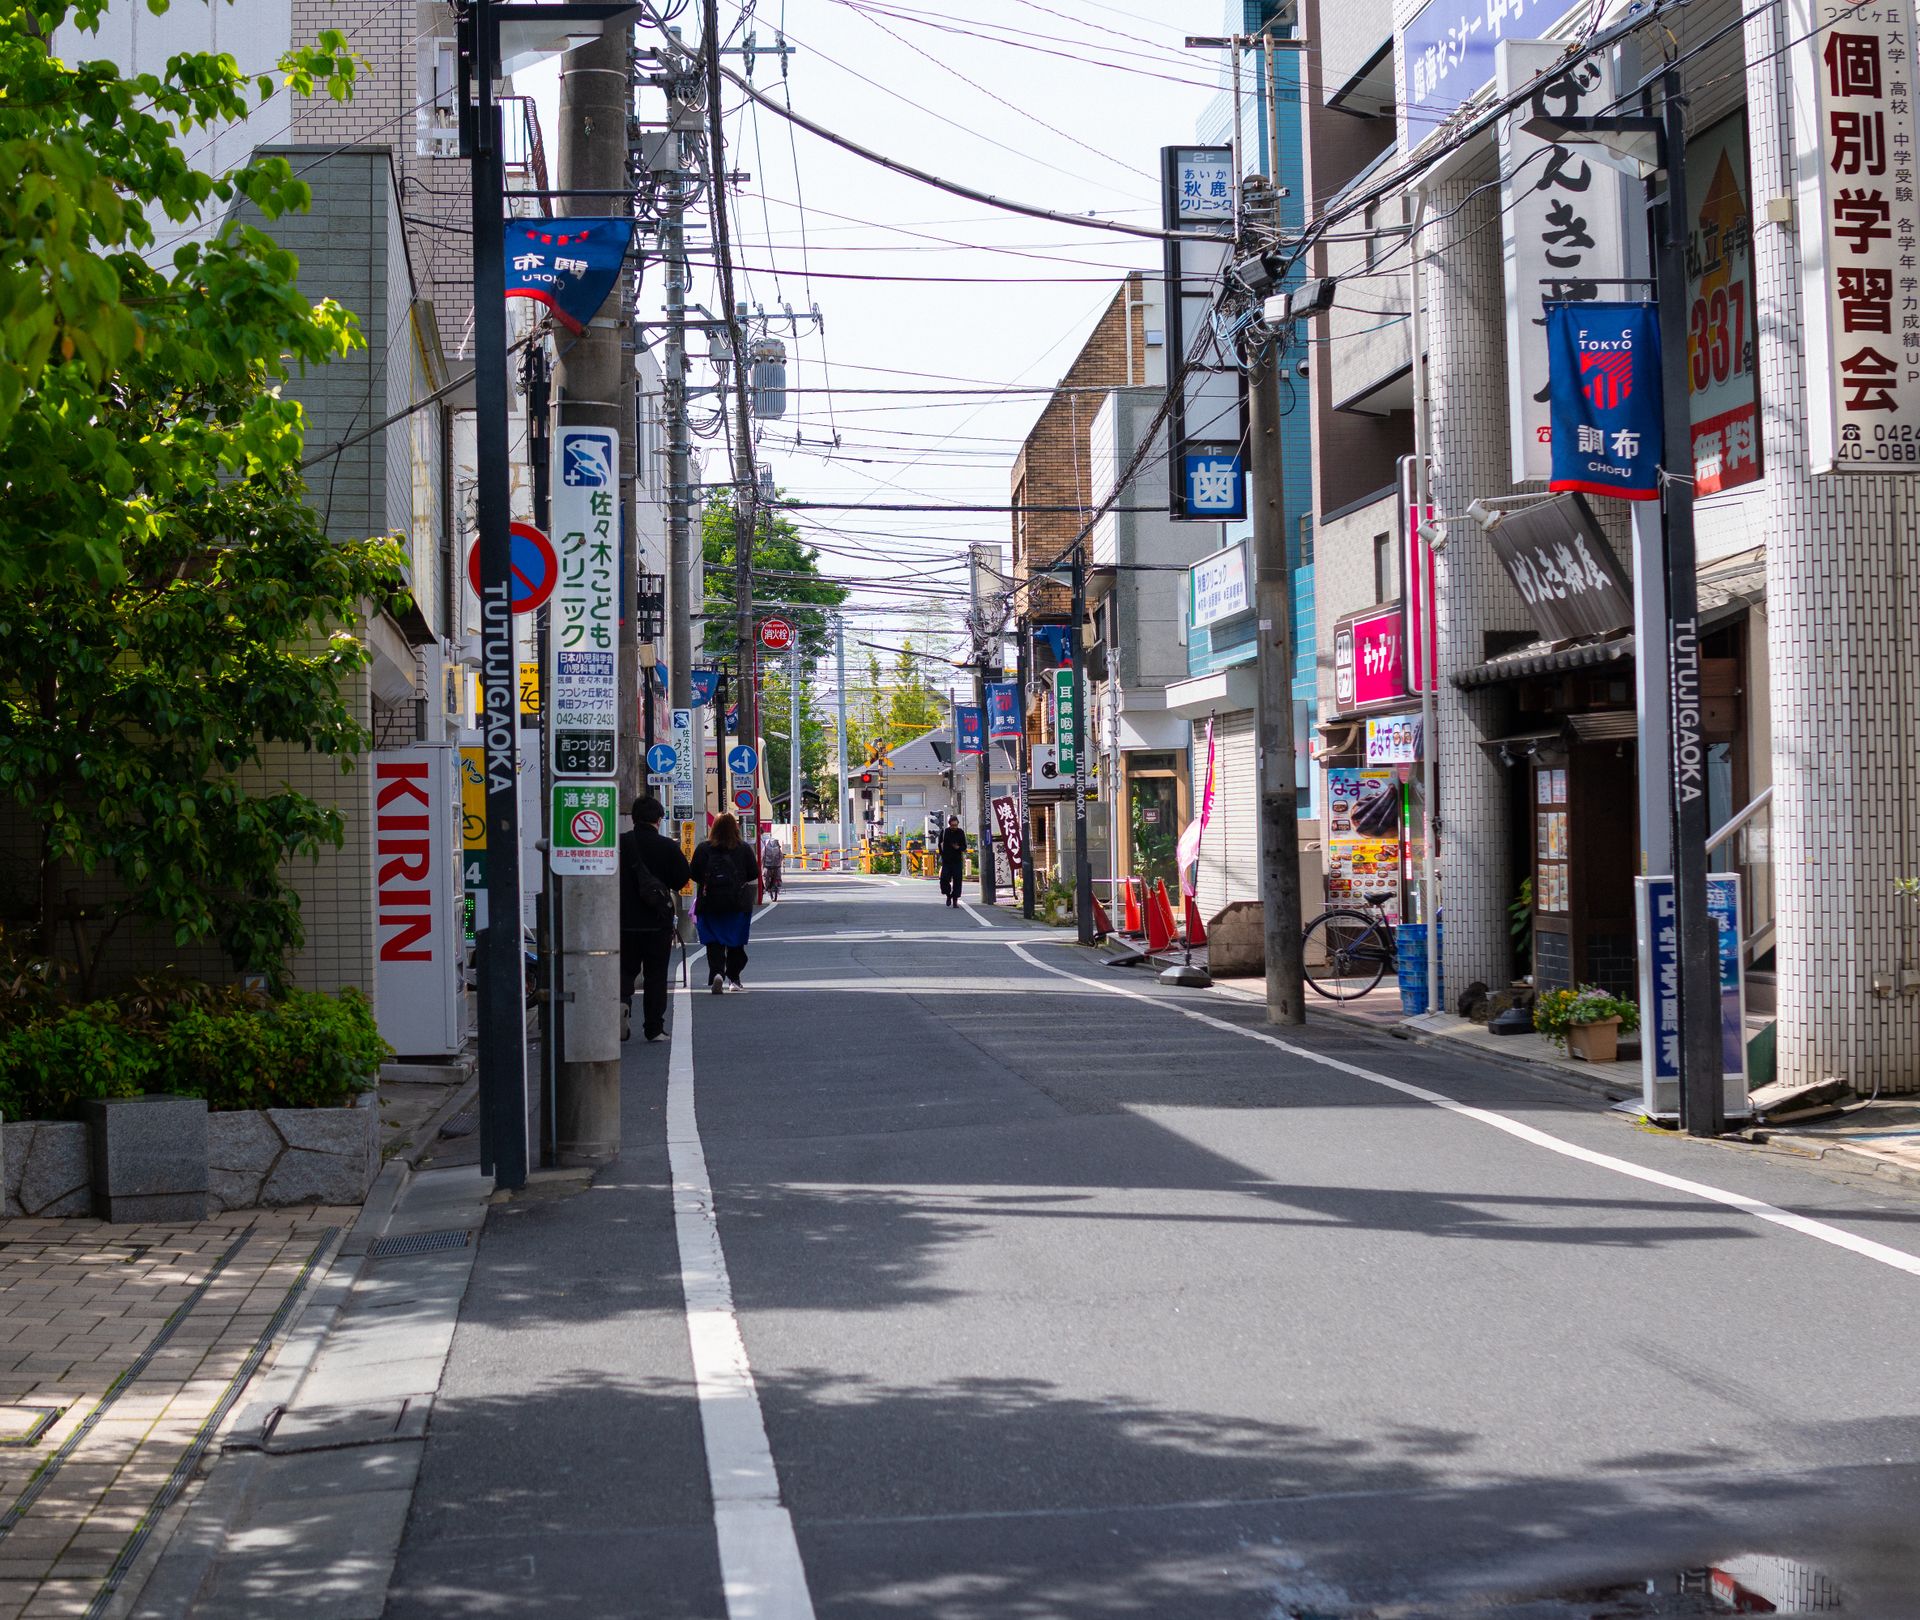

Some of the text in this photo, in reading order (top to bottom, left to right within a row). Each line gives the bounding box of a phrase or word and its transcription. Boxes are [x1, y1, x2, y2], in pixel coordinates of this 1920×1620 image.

[1413, 16, 1482, 104] 臨海セミナー
[1193, 152, 1215, 163] 2F
[1184, 168, 1227, 180] あいか
[1184, 181, 1227, 198] 秋鹿
[1180, 199, 1233, 211] クリニック
[1823, 31, 1899, 413] 個別学習会
[1579, 329, 1632, 339] F C
[1579, 340, 1632, 351] TOKYO
[1203, 445, 1222, 456] 1F
[1577, 424, 1640, 460] 調布
[1693, 414, 1757, 482] 無料
[1838, 443, 1920, 461] 40-088
[1190, 461, 1238, 508] 歯
[1587, 461, 1632, 478] CHOFU
[590, 490, 612, 649] 佐々木こども
[561, 532, 586, 648] クリニック
[764, 628, 788, 640] 消火栓
[1363, 633, 1402, 677] キッチン
[484, 581, 513, 795] TUTUJIGAOKA
[1676, 617, 1702, 803] TUTUJIGAOKA
[567, 755, 606, 768] 3-32
[682, 729, 691, 780] 佐々木こども
[564, 792, 610, 808] 通学路
[1076, 751, 1086, 820] TUTUJIGAOKA
[1330, 775, 1366, 801] なす
[377, 763, 433, 962] KIRIN
